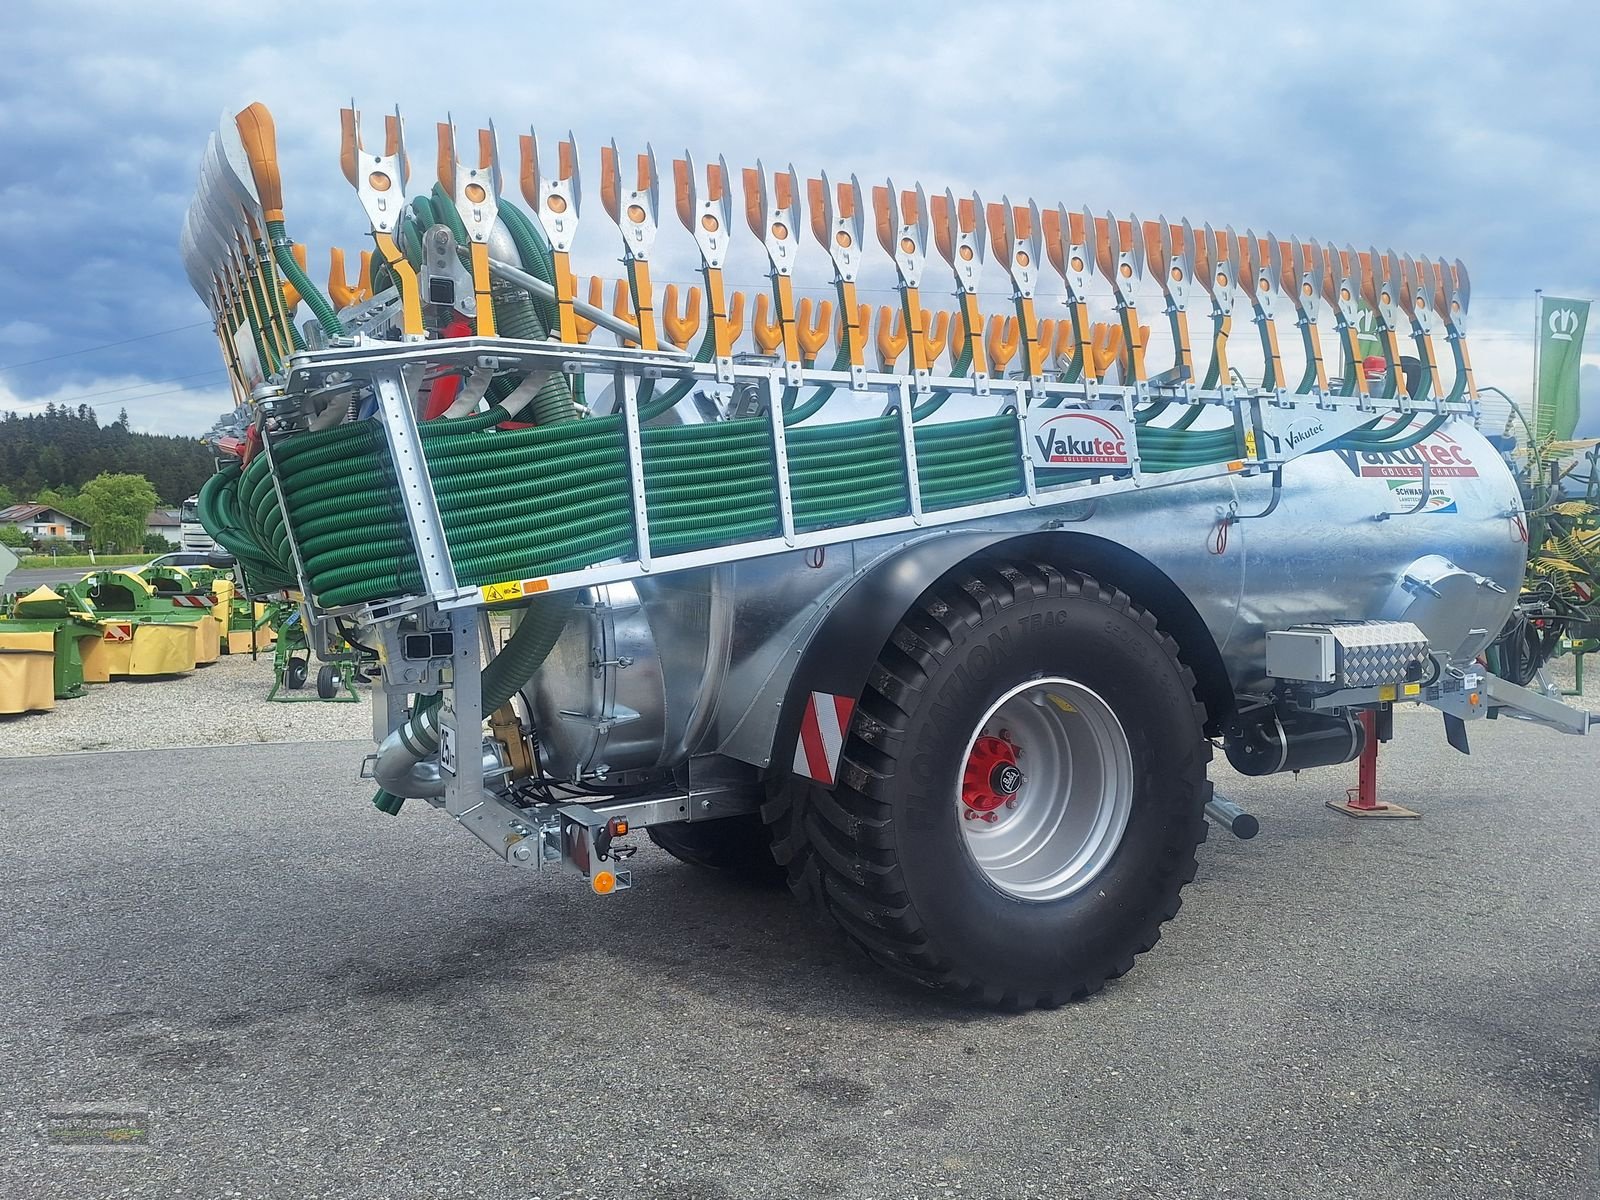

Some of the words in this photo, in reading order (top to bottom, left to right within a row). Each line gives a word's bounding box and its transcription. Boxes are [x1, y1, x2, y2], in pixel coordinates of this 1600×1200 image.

[1035, 428, 1127, 462] Vakutec
[1285, 424, 1324, 450] Vakutec
[1381, 467, 1460, 476] GÜLLE-TCHNIK
[1395, 488, 1445, 496] SCHWARAYR
[1017, 610, 1067, 635] TRAC
